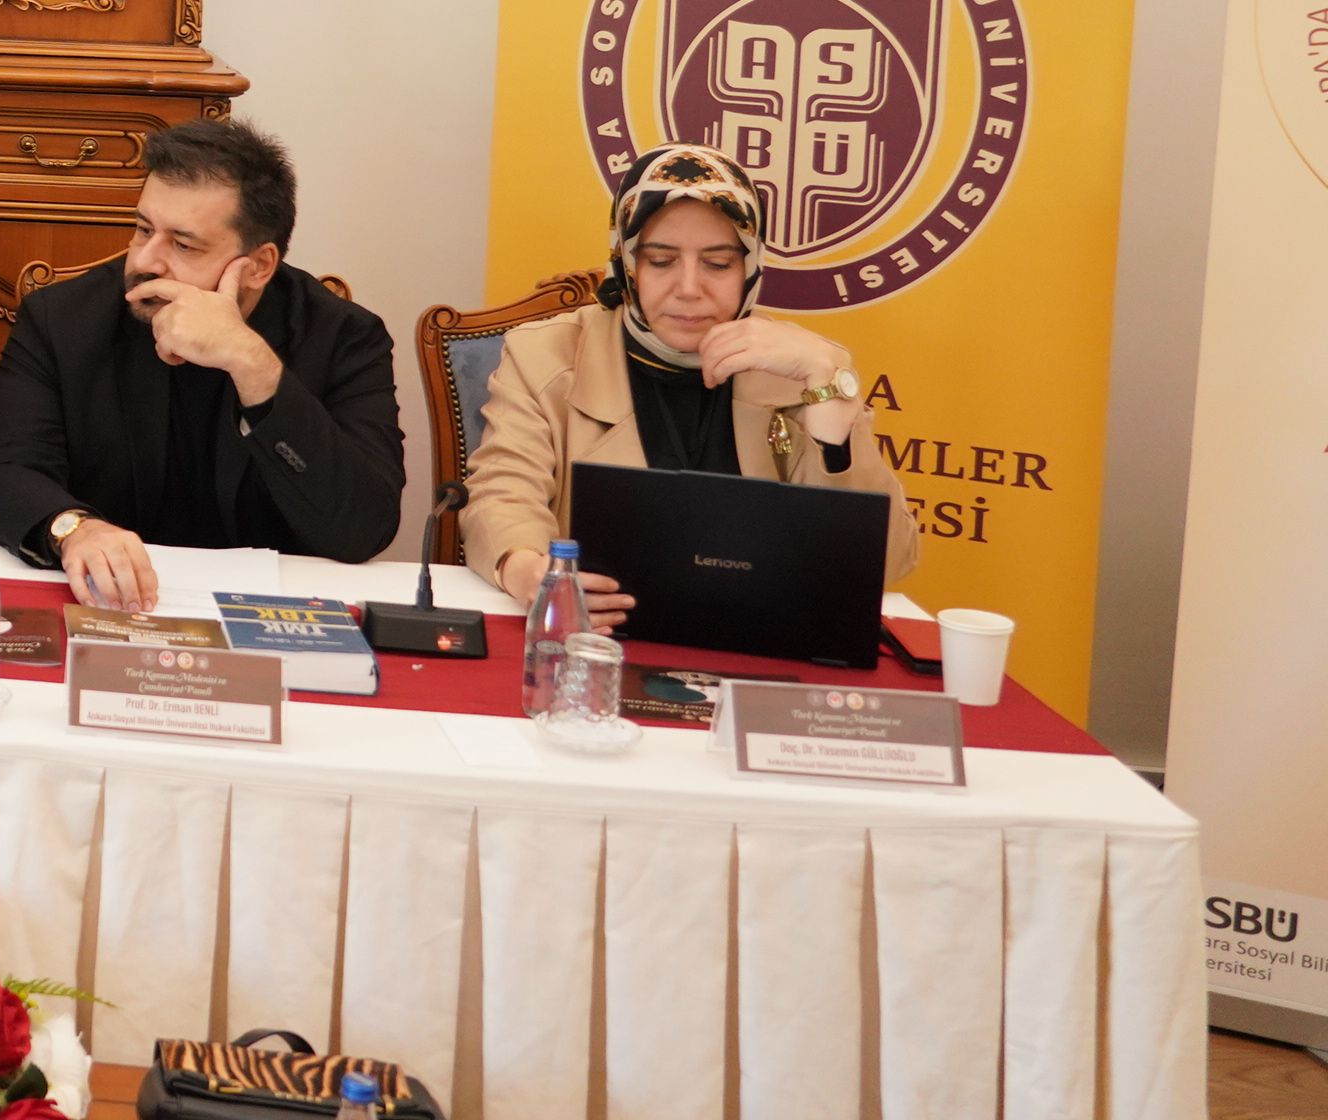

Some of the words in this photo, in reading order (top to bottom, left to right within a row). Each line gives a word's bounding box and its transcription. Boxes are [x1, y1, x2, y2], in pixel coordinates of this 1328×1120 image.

[872, 434, 1052, 490] MLER
[694, 554, 752, 571] Lenovo
[1204, 896, 1298, 942] SBÜ
[1205, 937, 1230, 952] ara
[1236, 941, 1295, 965] Sosyal
[1302, 954, 1328, 972] Bili
[1206, 958, 1272, 981] ersitesi
